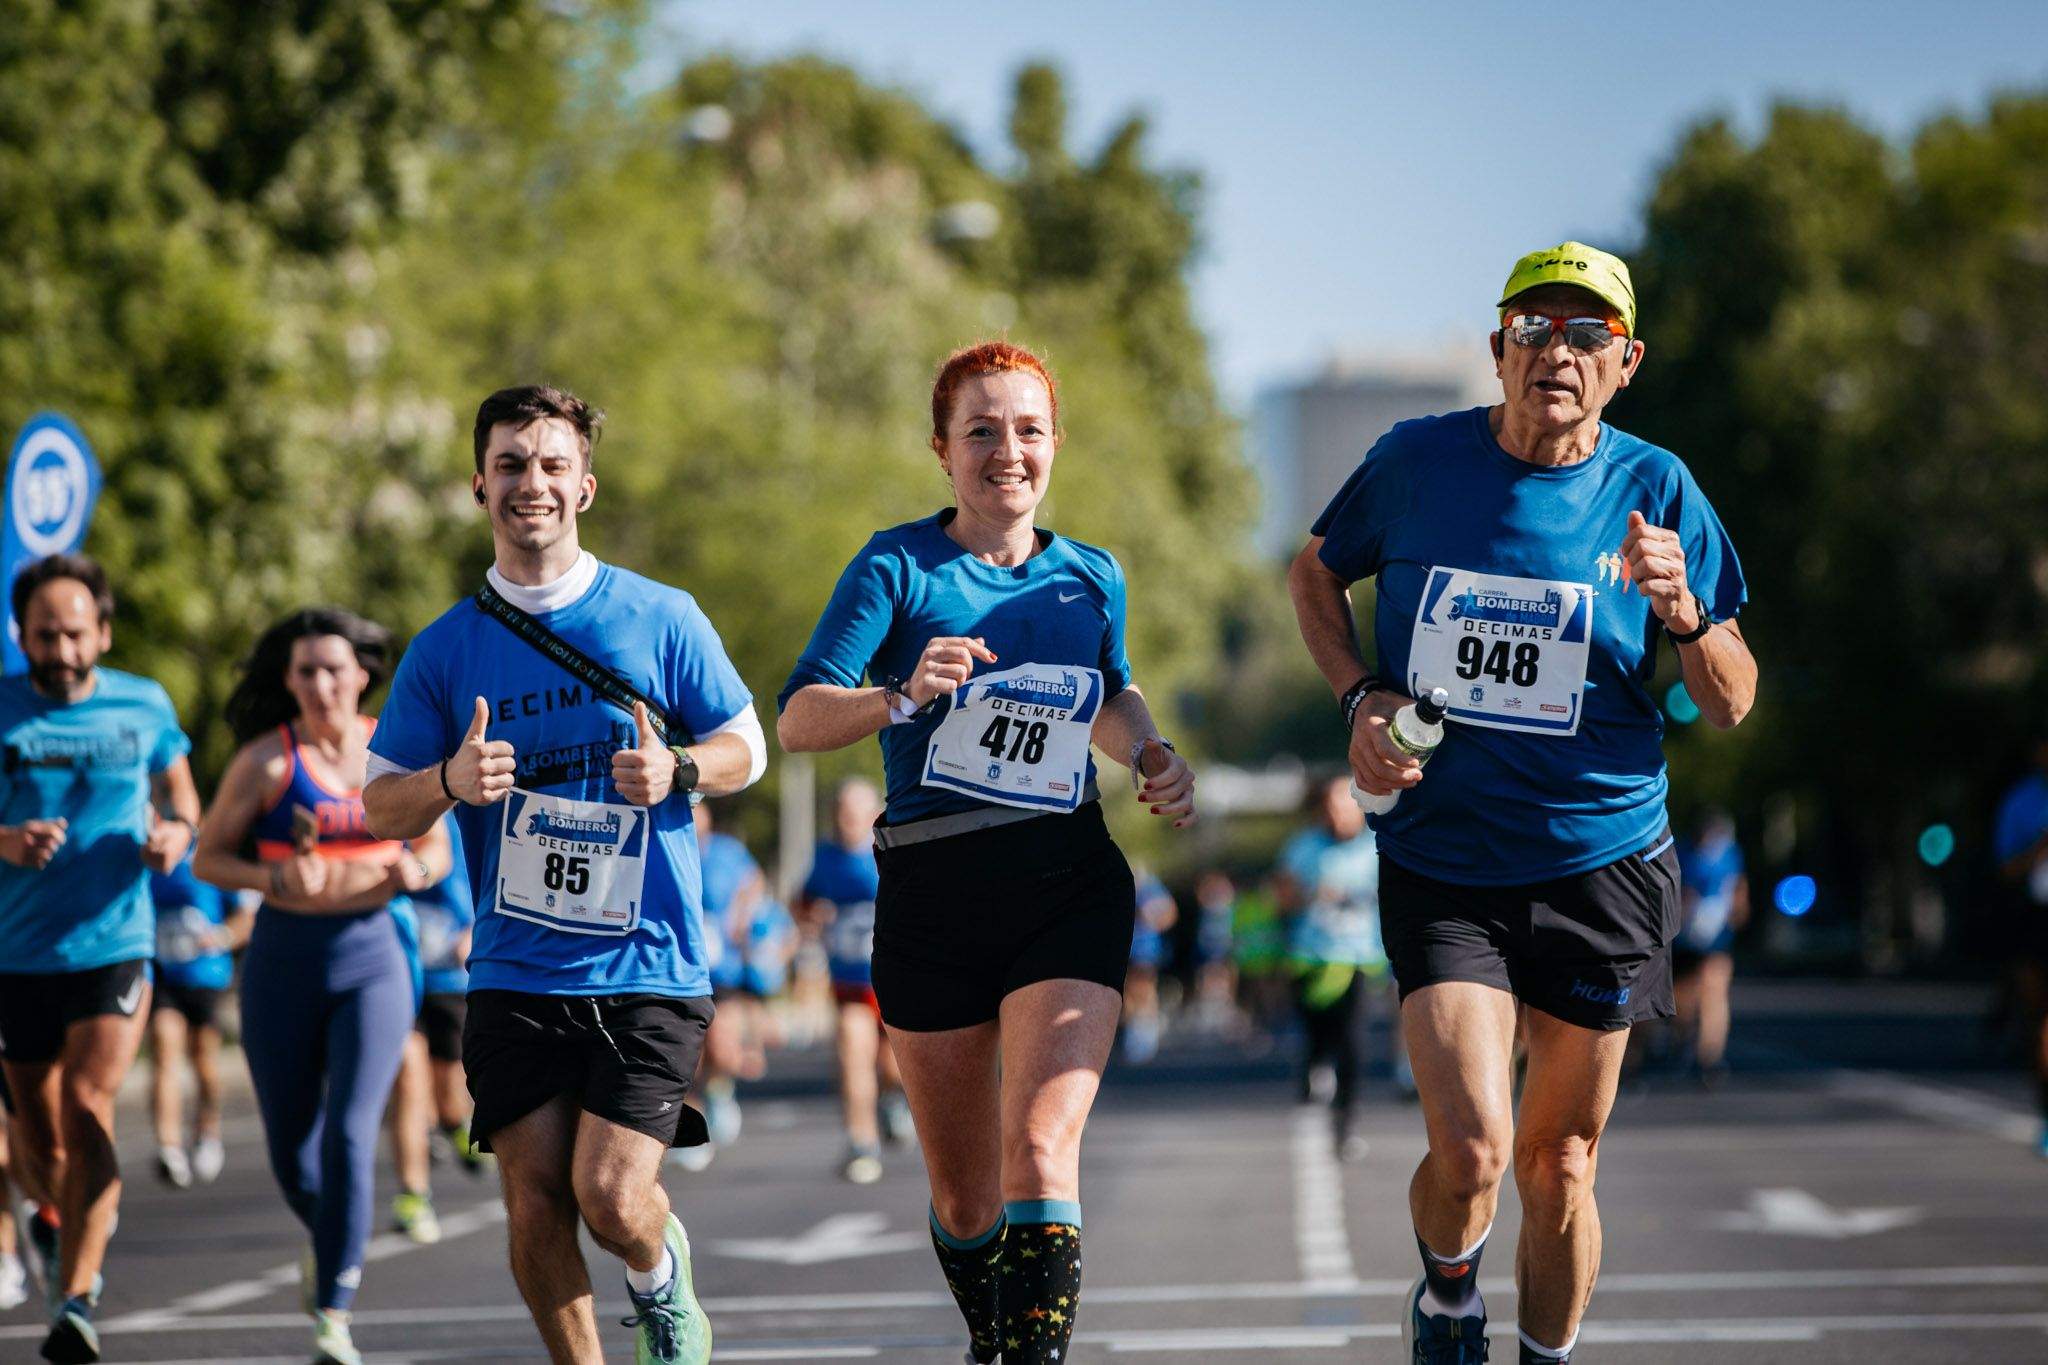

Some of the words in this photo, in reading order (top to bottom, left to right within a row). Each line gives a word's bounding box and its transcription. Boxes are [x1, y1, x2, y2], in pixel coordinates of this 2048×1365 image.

[1476, 596, 1557, 614] BOMBEROS
[1464, 620, 1552, 640] DECIMAS
[1456, 636, 1540, 687] 948
[1007, 678, 1075, 697] BOMBEROS
[991, 699, 1067, 721] DECIMAS
[979, 715, 1049, 765] 478
[548, 816, 617, 833] BOMBEROS
[539, 836, 613, 856] DECIMAS
[544, 853, 590, 896] 85
